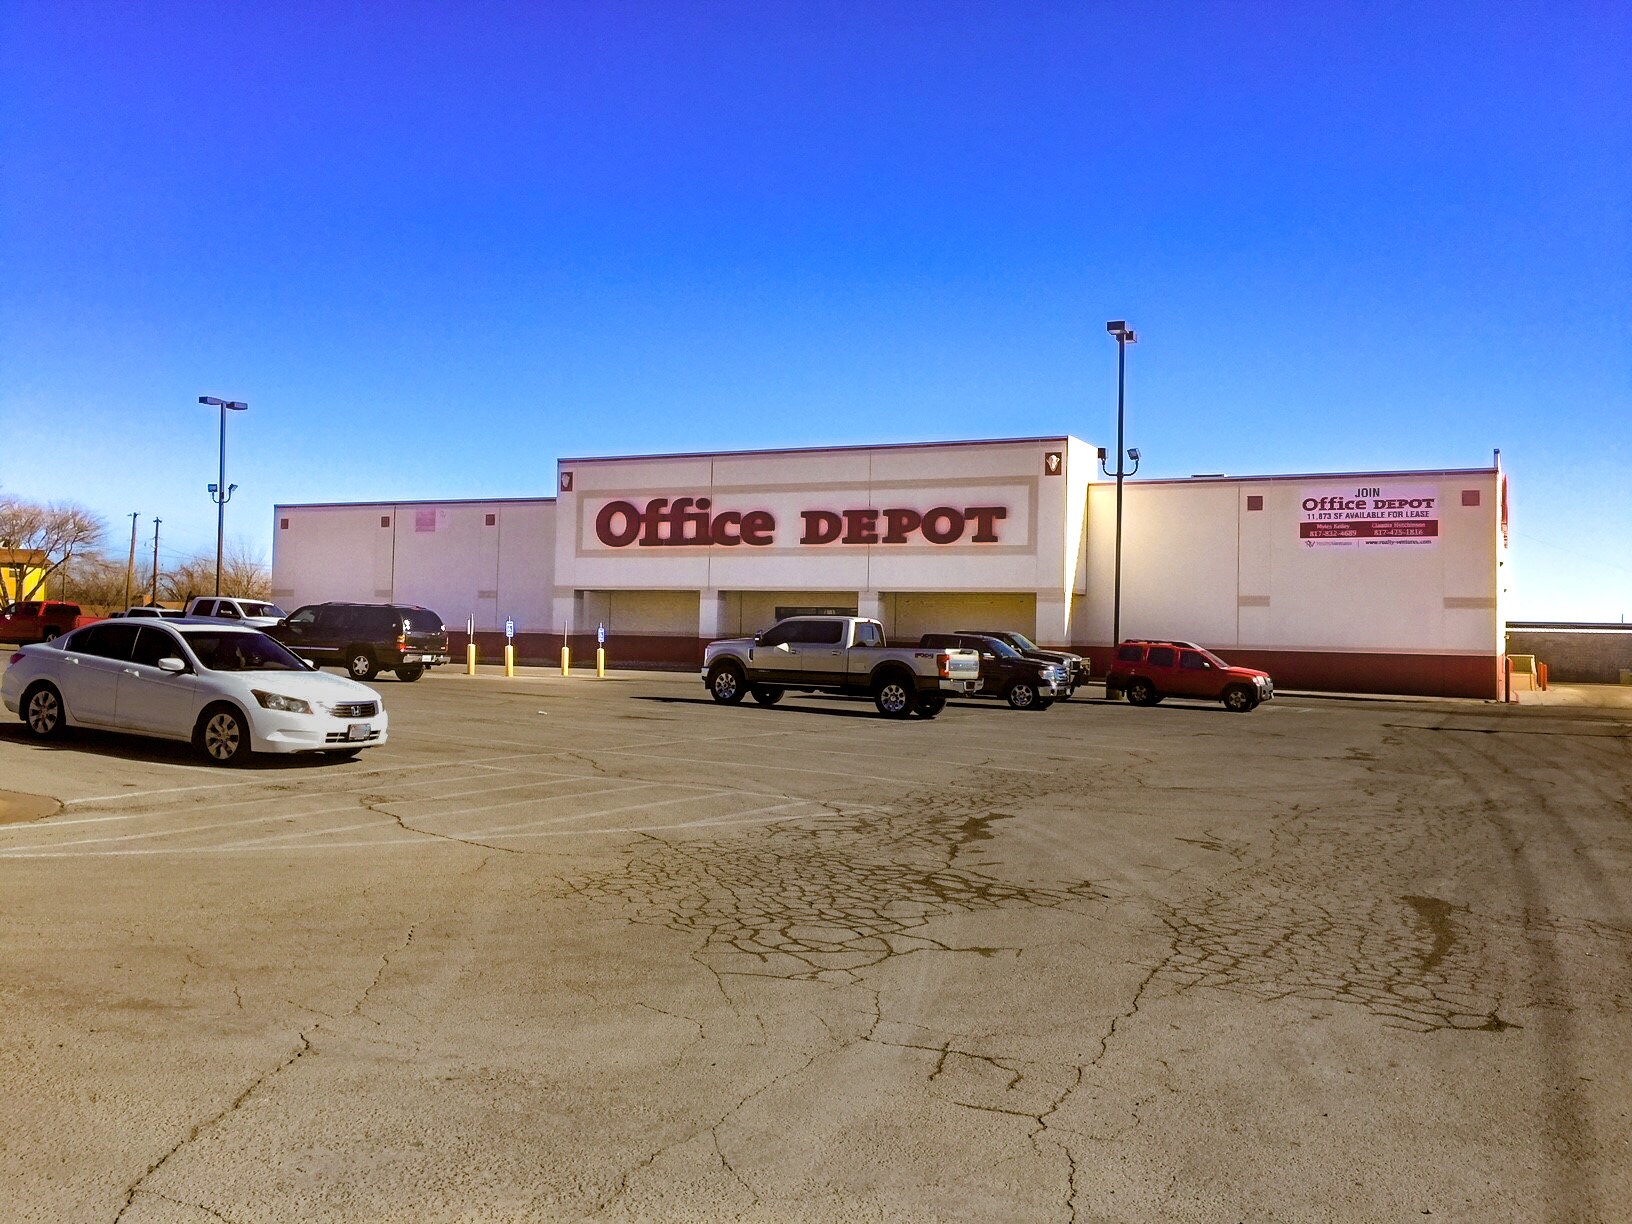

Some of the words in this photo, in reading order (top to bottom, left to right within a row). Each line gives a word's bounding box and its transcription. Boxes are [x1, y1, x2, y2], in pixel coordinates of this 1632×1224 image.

[1355, 487, 1380, 498] JOIN
[1302, 497, 1367, 511] Office
[1373, 498, 1435, 510] DEPOT
[1345, 511, 1386, 519] AVAILABLE
[1406, 510, 1430, 518] LEASE
[595, 497, 776, 548] Office
[799, 506, 1007, 545] DEPOT
